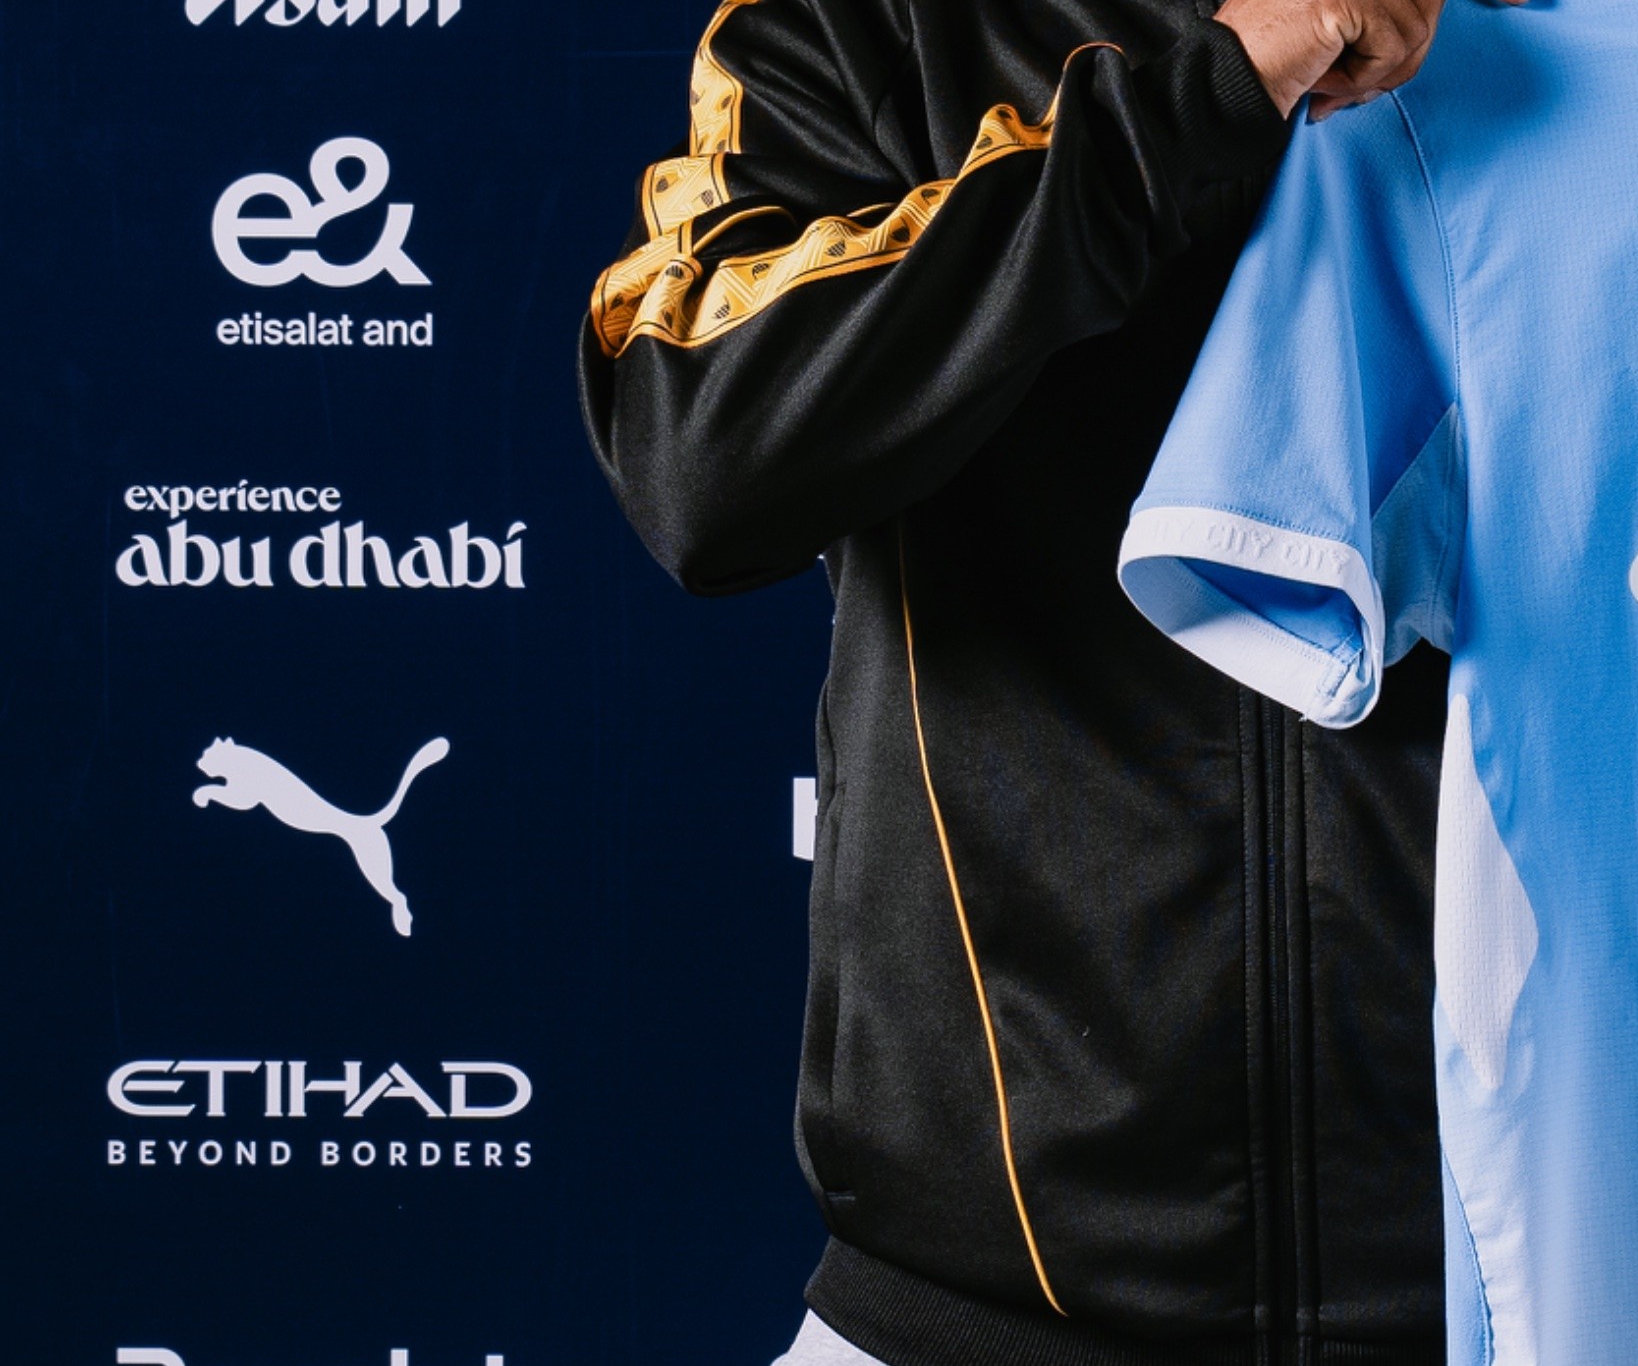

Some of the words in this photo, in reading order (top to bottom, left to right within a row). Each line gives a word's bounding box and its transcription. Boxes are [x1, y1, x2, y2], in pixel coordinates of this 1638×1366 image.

[216, 311, 353, 346] etisalat
[362, 313, 433, 346] and
[115, 519, 274, 587] abu
[107, 1061, 532, 1118] ETIHAD
[108, 1140, 291, 1166] BEYOND
[321, 1141, 531, 1167] BORDERS
